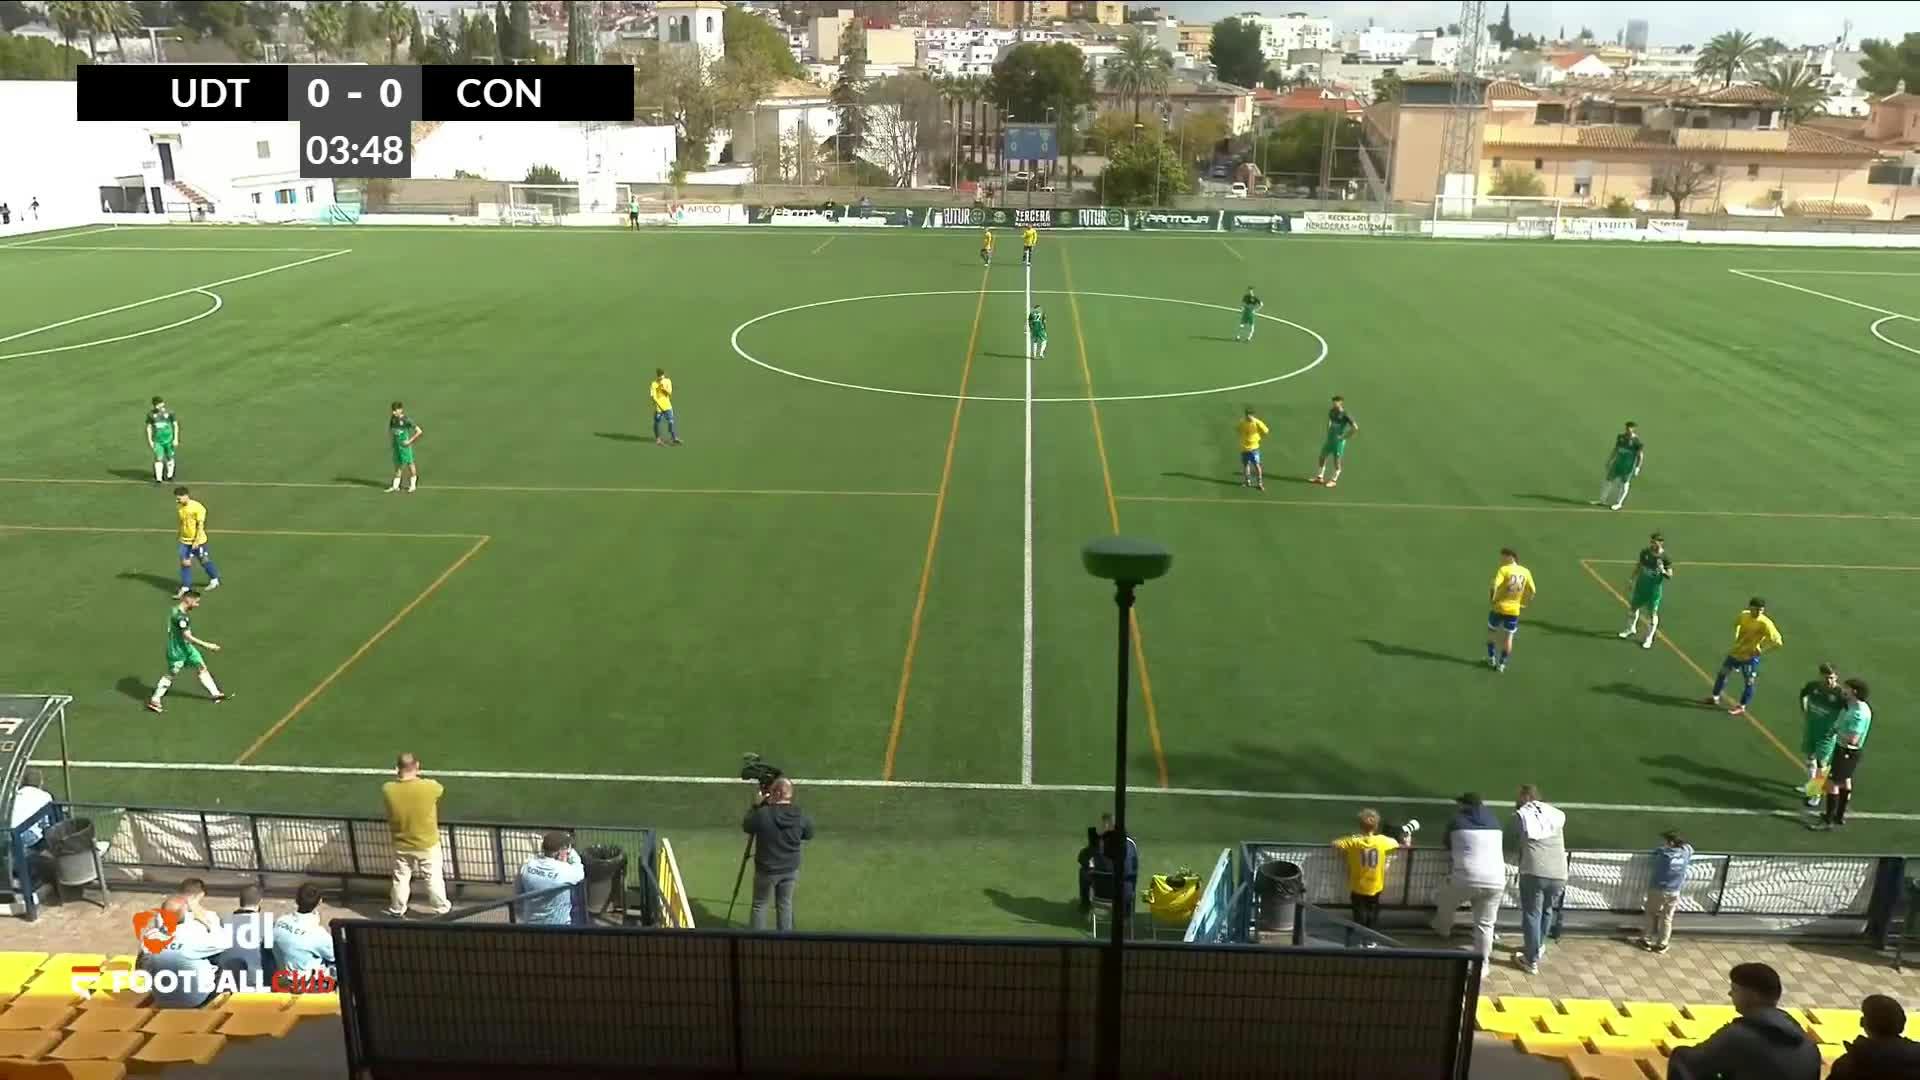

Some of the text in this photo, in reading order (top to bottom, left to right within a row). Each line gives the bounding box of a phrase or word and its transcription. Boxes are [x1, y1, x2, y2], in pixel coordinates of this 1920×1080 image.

[1015, 209, 1051, 222] TERCERA
[1146, 214, 1209, 224] PANTOJA
[1360, 848, 1379, 868] 10
